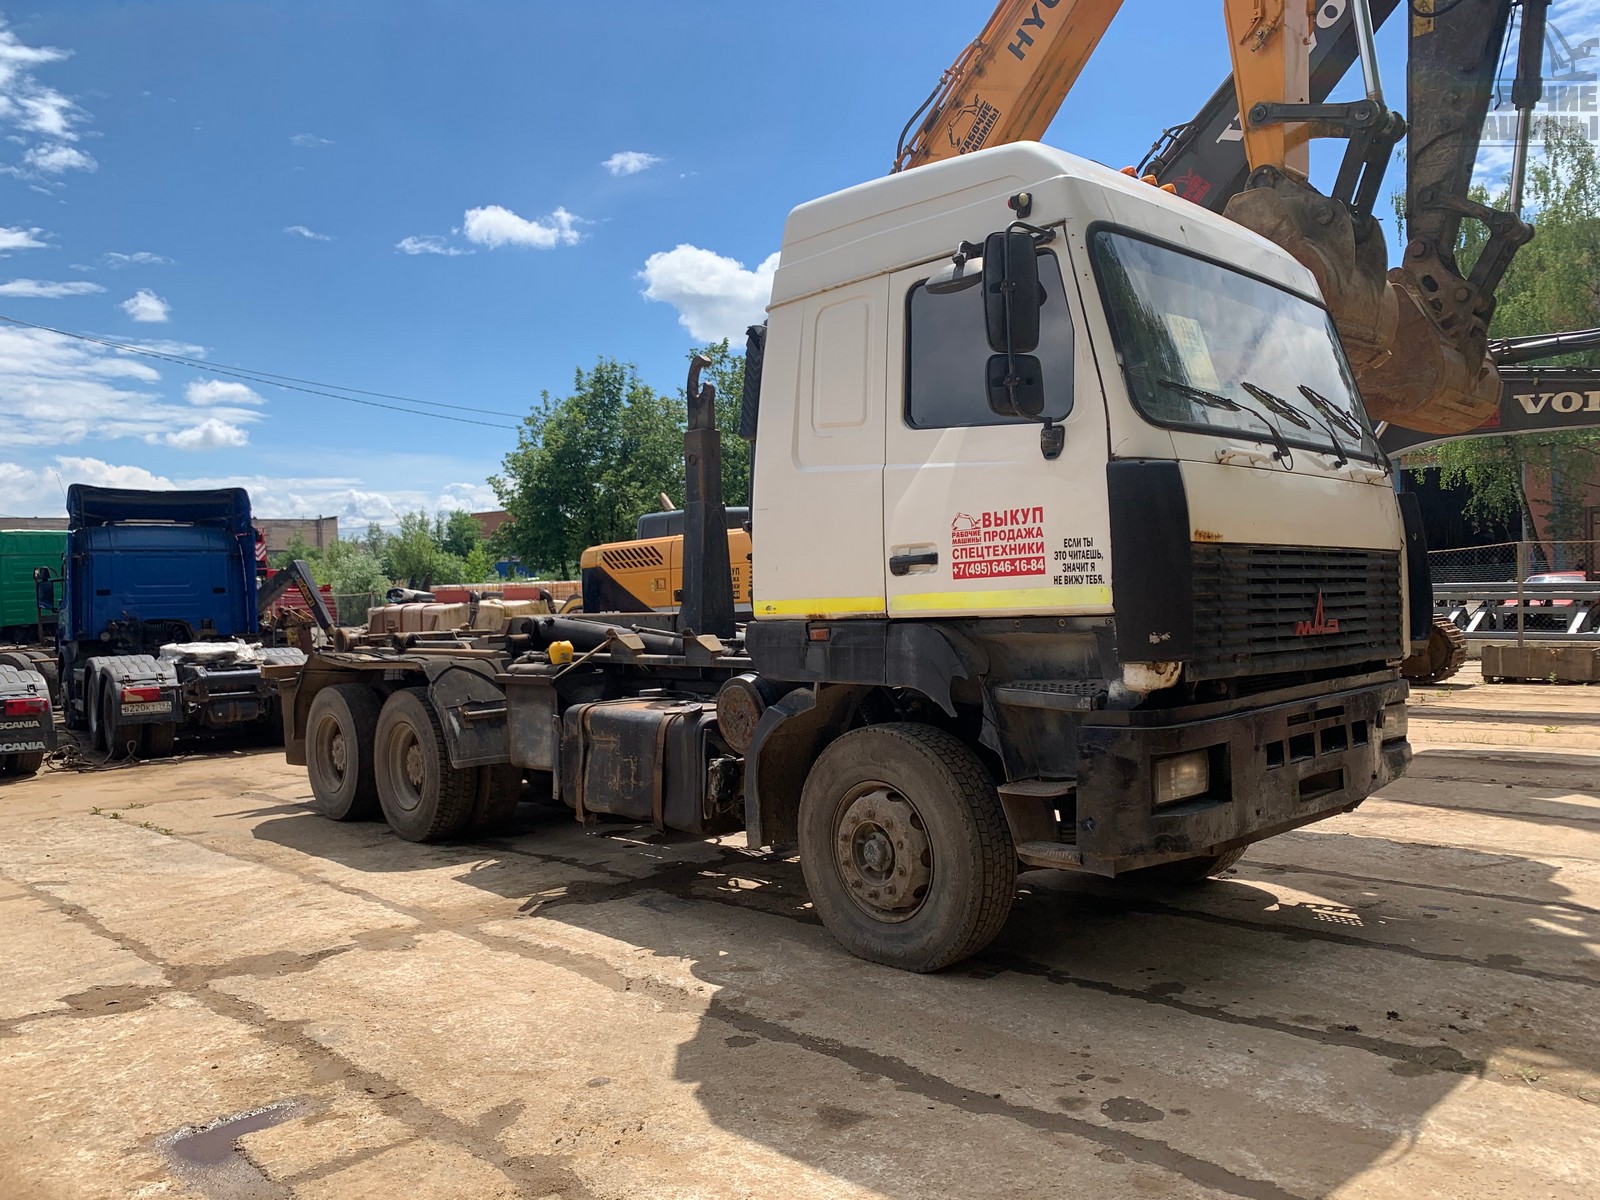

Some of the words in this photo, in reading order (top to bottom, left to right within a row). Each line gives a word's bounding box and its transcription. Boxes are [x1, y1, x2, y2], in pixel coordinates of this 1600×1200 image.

[959, 102, 991, 155] РАБОЧИЕ
[968, 107, 1000, 152] АШИНЫ
[982, 506, 1044, 529] ВЫКУП
[951, 530, 981, 539] РАБОЧИЕ
[951, 536, 982, 545] МАШИНЫ
[983, 526, 1044, 542] ПРОДАЖА
[1063, 537, 1082, 548] ЕСЛИ
[1083, 537, 1094, 547] ТЫ
[952, 541, 1045, 560] СПЕЦТЕХНИКИ
[1053, 551, 1067, 560] ЭТО
[1068, 549, 1104, 561] ЧИТАЕШЬ,
[991, 558, 1045, 574] 646-16-84
[1062, 562, 1089, 573] ЗНАЧИТ
[1090, 562, 1096, 572] Я
[1053, 575, 1063, 585] НЕ
[1064, 574, 1085, 585] ВИЖУ
[1085, 574, 1105, 585] ТЕБЯ.
